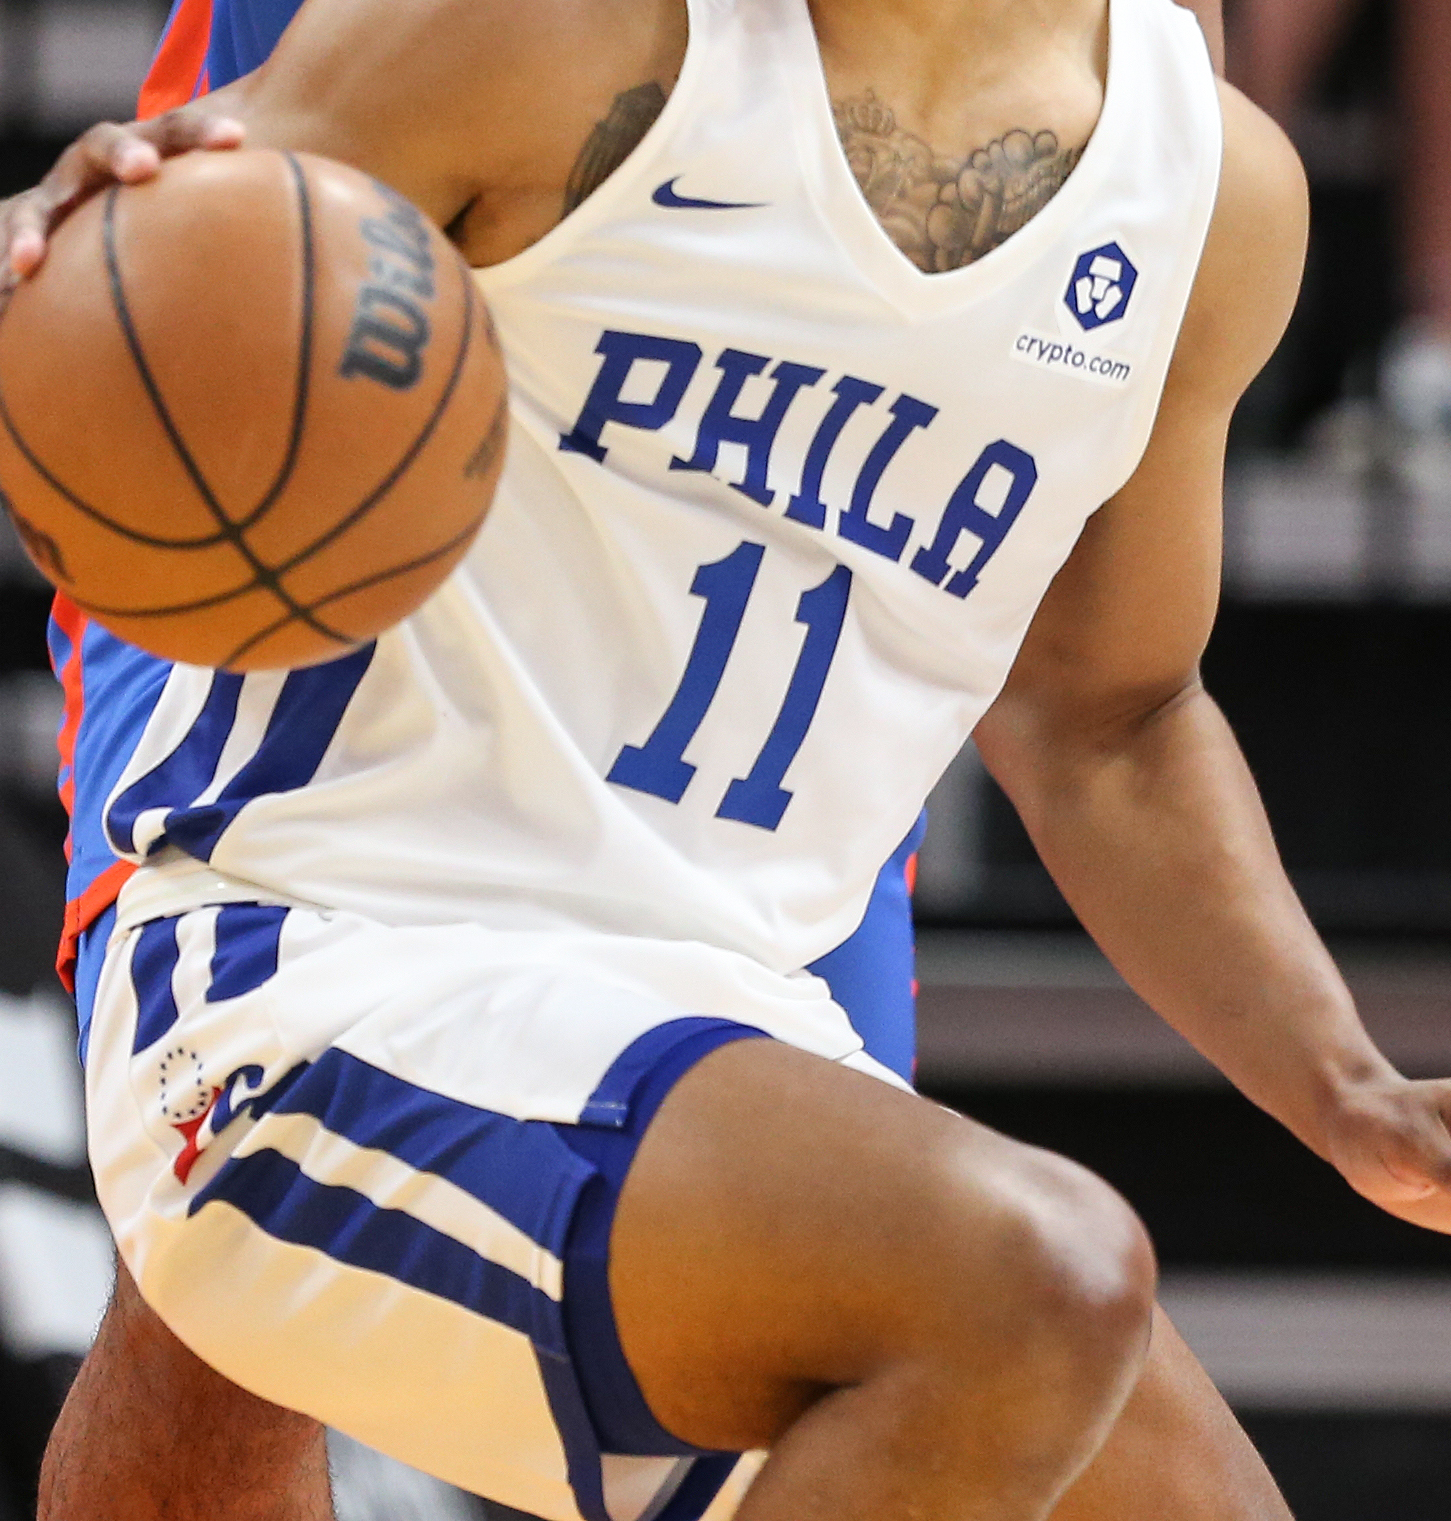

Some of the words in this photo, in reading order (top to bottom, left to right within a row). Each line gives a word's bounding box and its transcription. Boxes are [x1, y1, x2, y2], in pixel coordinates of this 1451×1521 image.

[558, 329, 1039, 601] PHILA
[1014, 331, 1132, 383] crypto.com
[605, 539, 854, 833] 11
